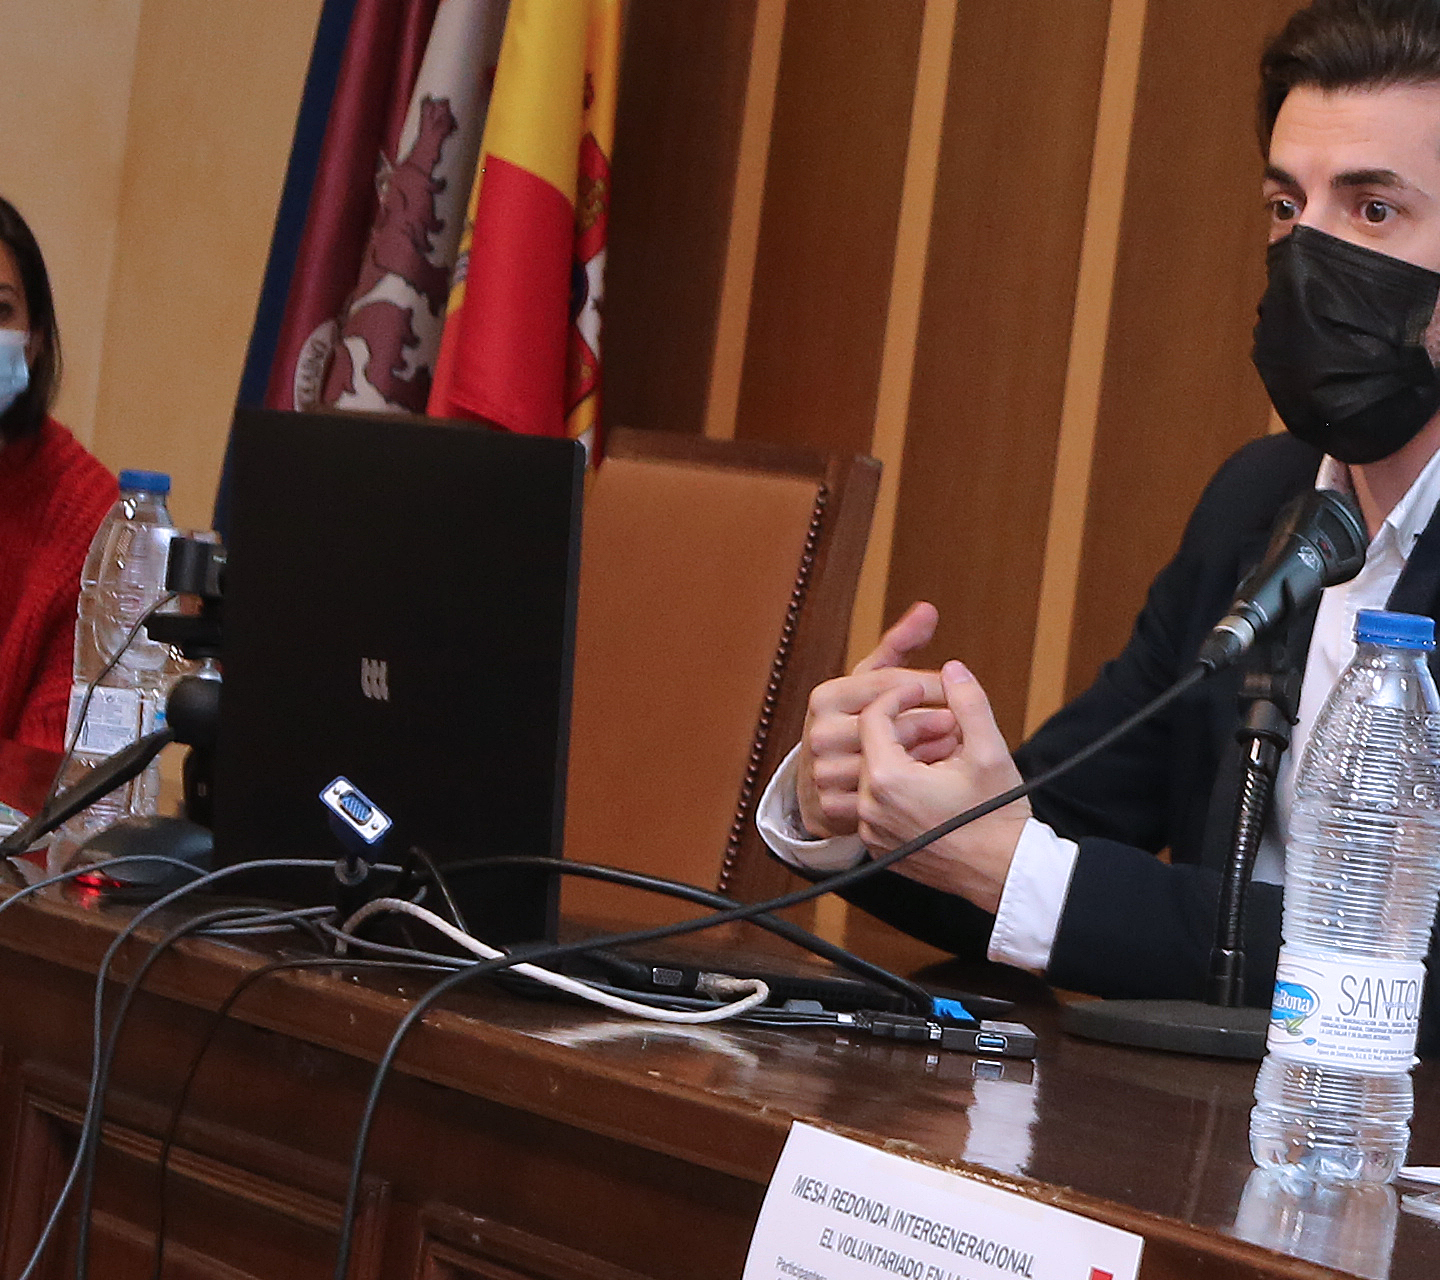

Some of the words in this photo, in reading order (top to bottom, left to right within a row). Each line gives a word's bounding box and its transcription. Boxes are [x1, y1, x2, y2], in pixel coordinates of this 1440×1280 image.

[791, 1175, 828, 1204] MESA
[827, 1188, 890, 1226] REDONDA
[891, 1210, 1032, 1278] INTERGENERACIONAL
[818, 1227, 834, 1249] EL
[837, 1233, 923, 1280] VOLUNTARIADO
